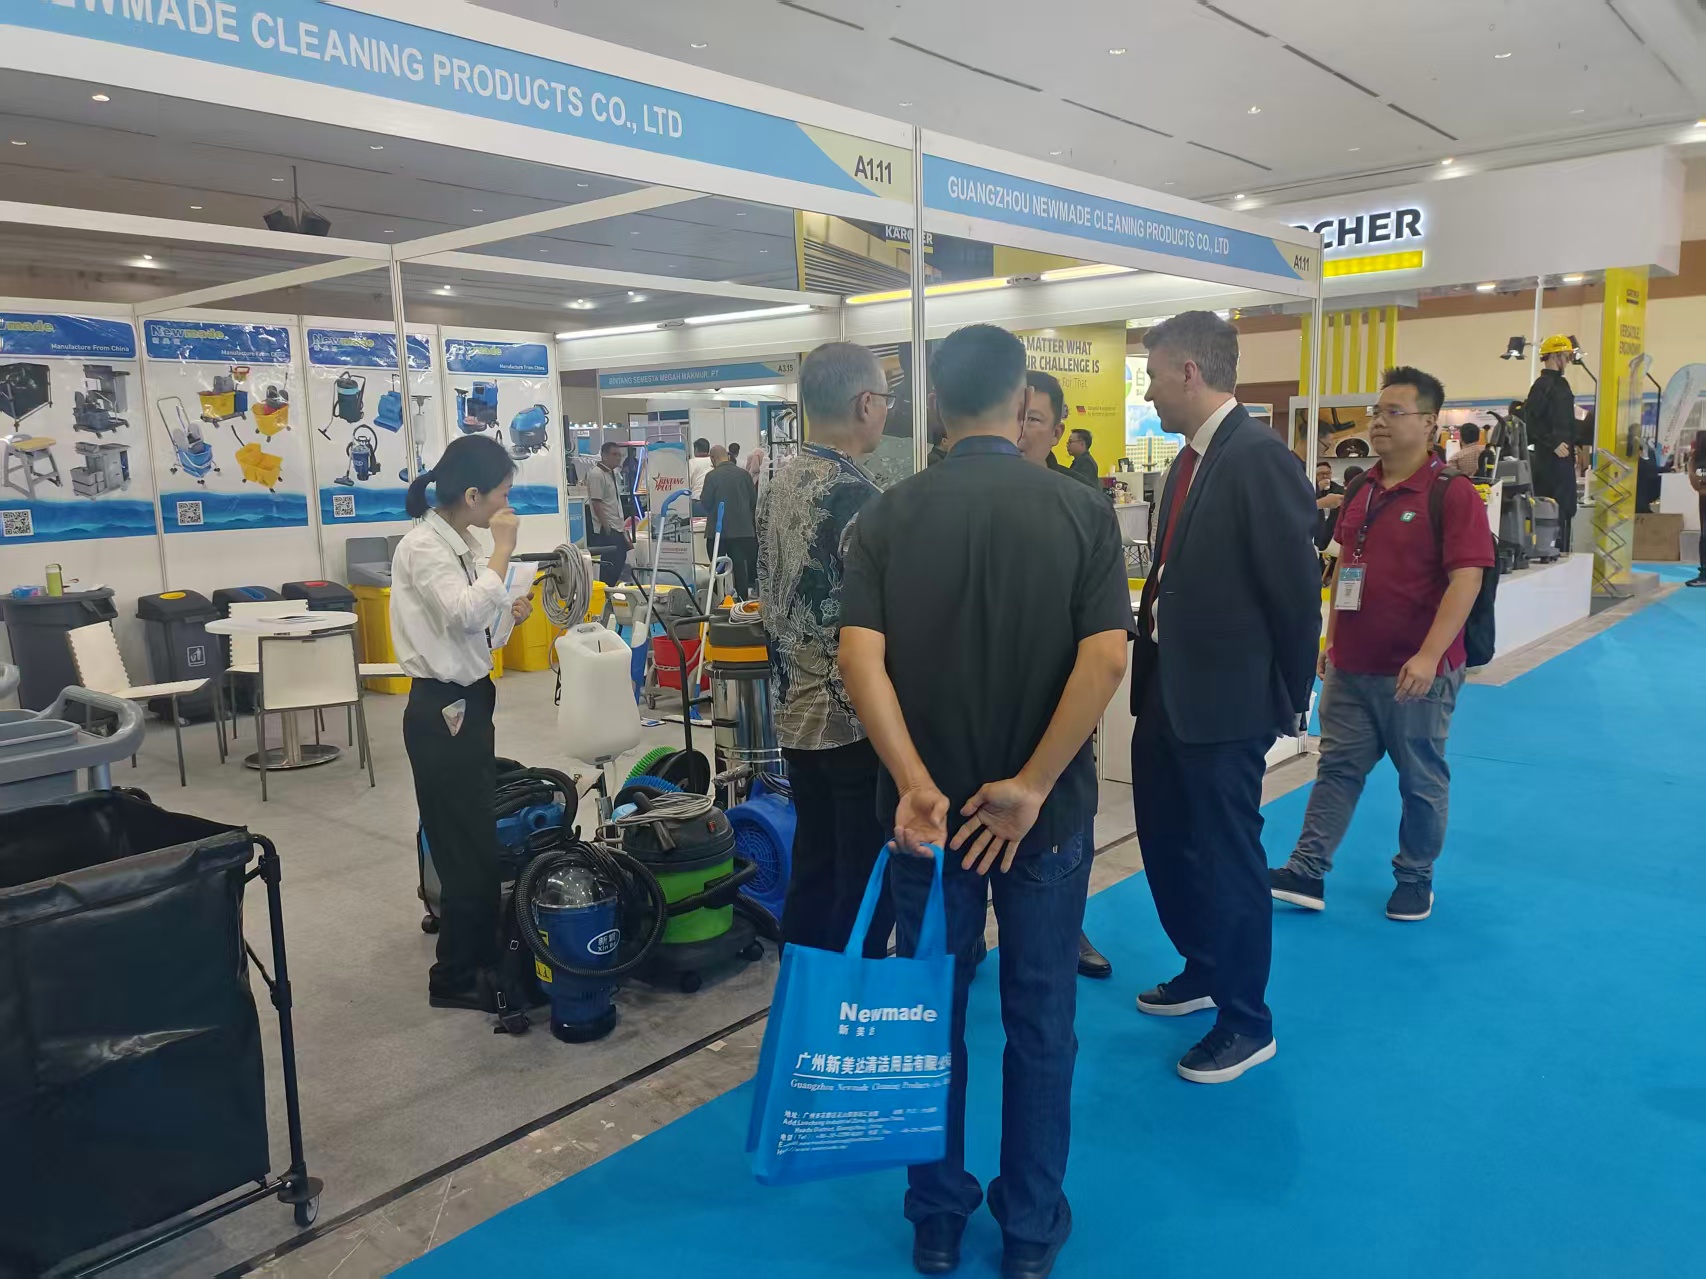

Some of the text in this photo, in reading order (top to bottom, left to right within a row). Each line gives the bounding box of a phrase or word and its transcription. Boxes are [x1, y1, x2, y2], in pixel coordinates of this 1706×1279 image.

[252, 12, 424, 81] CLEANING
[433, 53, 583, 117] PRODUCTS
[591, 92, 637, 134] CO.,
[643, 104, 683, 138] LTD
[854, 155, 892, 184] A1.11
[948, 176, 1030, 213] GUANGZHOU
[1032, 196, 1091, 226] NEWMADE
[1093, 211, 1145, 237] CLEANING
[1146, 222, 1195, 248] PRODUCTS
[1214, 236, 1230, 255] LTD
[1293, 254, 1310, 272] A1.11
[151, 325, 224, 339] Newmade
[51, 343, 91, 351] Manufacture
[1026, 335, 1065, 354] MATTER
[1066, 339, 1093, 356] WHAT
[1039, 355, 1090, 374] CHALLENGE
[1092, 359, 1100, 373] IS
[660, 373, 680, 382] MEGAH
[840, 1001, 938, 1022] Newmade
[791, 1079, 834, 1092] Guangzhou
